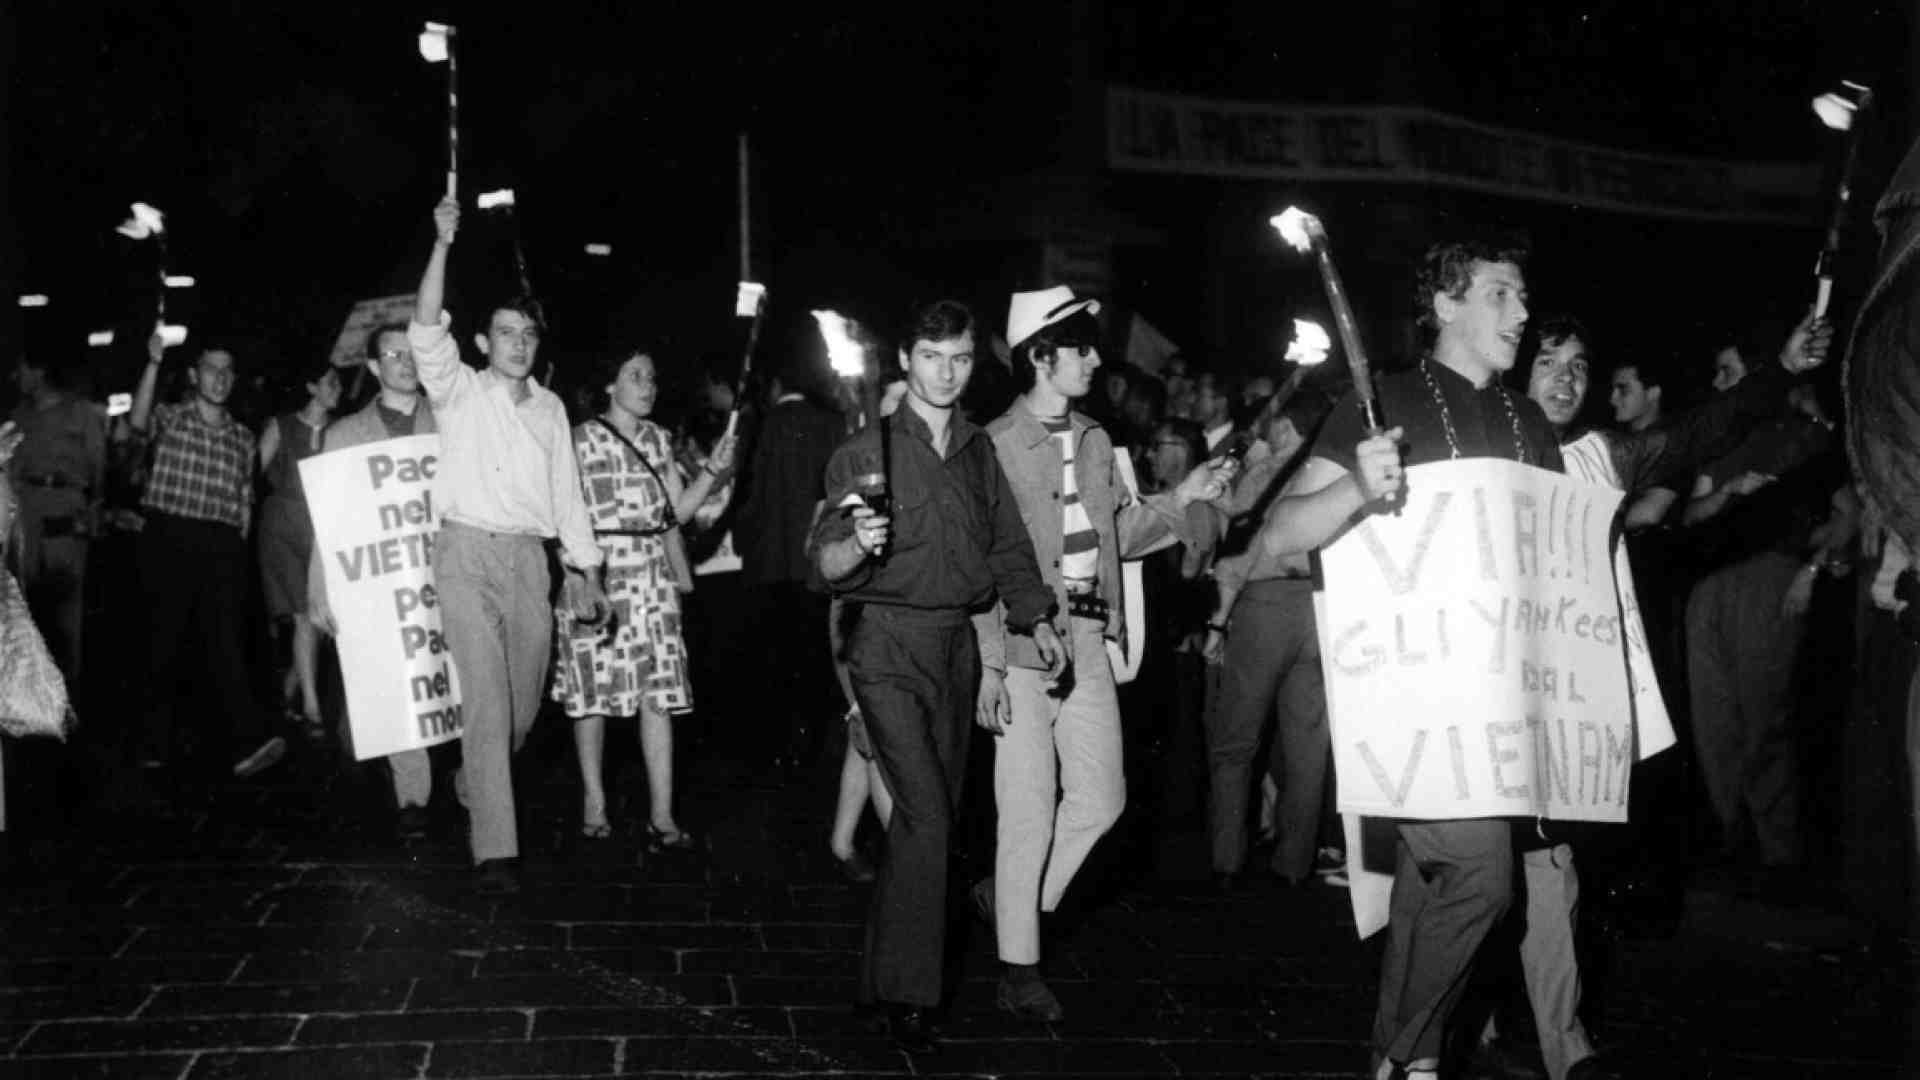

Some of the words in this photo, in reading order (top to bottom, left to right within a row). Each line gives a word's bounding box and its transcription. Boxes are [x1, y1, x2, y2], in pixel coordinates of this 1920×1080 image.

[367, 455, 438, 490] Pac
[378, 490, 432, 531] nel
[394, 584, 438, 622] pe
[401, 624, 449, 660] Pa
[1332, 606, 1450, 677] GLI
[411, 660, 451, 702] nel
[1354, 716, 1632, 807] VIETNAM
